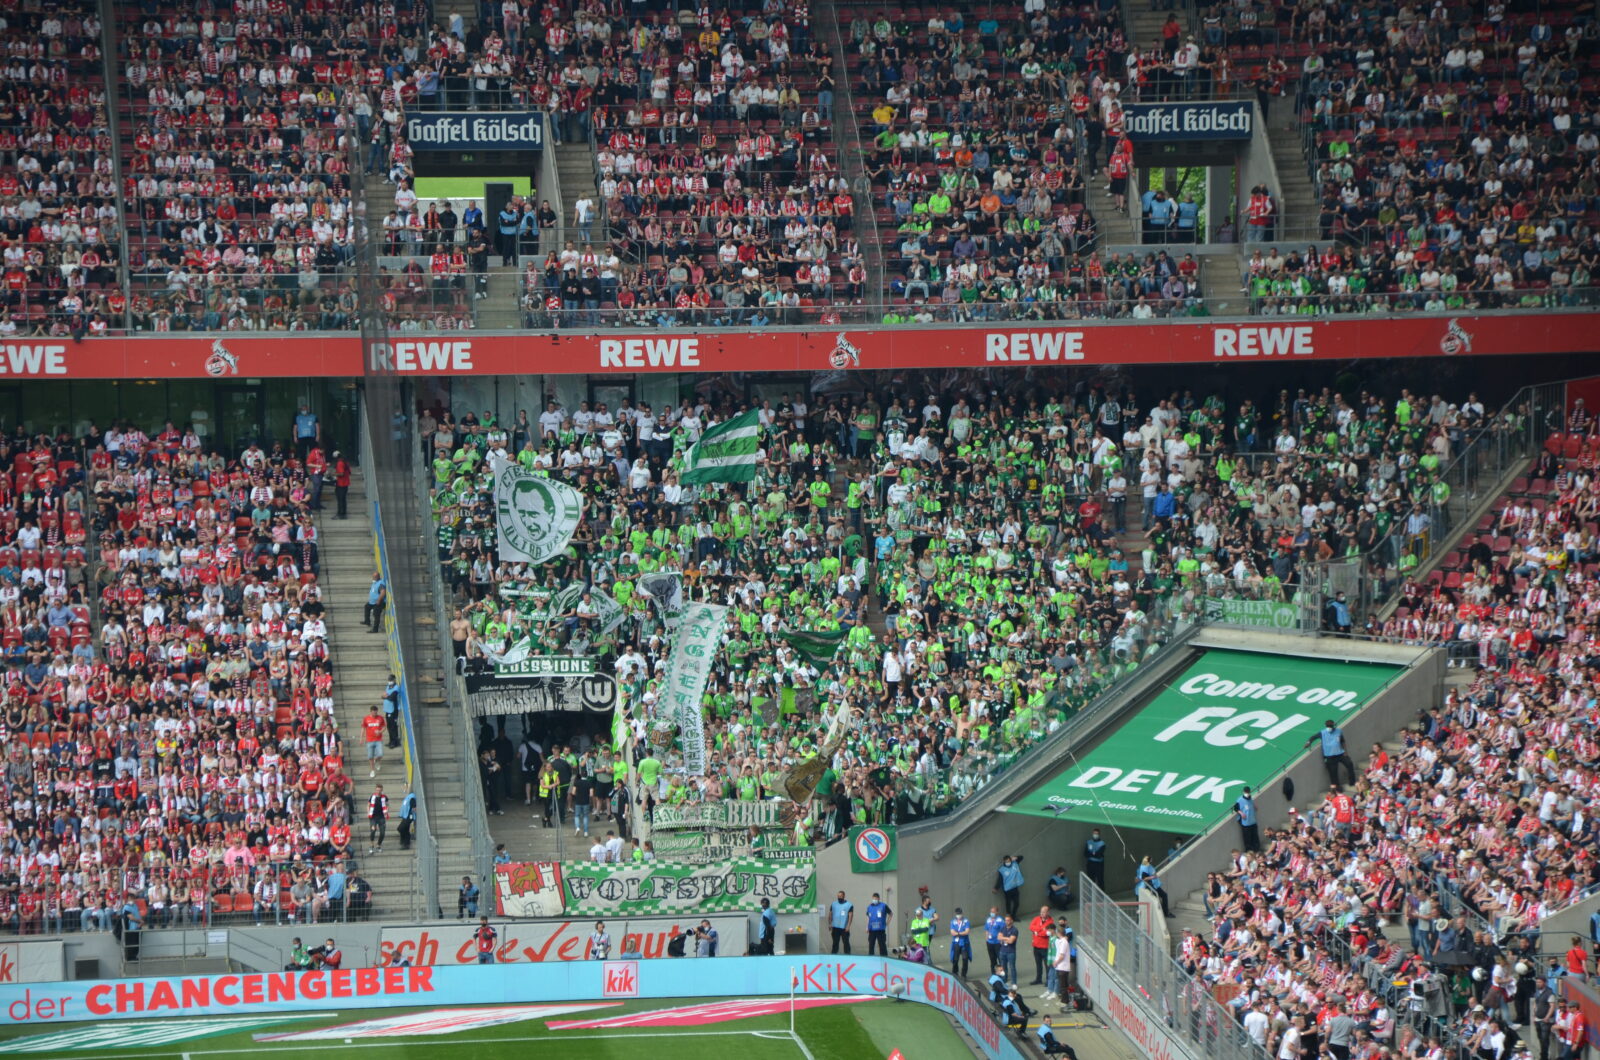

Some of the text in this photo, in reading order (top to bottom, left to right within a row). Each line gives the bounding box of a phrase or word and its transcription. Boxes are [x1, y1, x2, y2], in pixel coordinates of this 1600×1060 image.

[408, 117, 541, 145] Gaffel Kölsch
[1124, 106, 1251, 135] Gaffel Kölsch
[370, 342, 473, 371] REWE
[600, 338, 700, 368] REWE
[985, 332, 1085, 362] REWE
[1213, 326, 1315, 357] REWE
[1179, 673, 1358, 711] Come on,
[1153, 706, 1311, 751] FC!
[1067, 766, 1247, 803] DEVK
[1047, 795, 1204, 819] Gesagt. Getan. Geholfen.
[764, 850, 813, 859] SALZGITTER
[567, 872, 810, 901] WOLFSBURG
[8, 966, 435, 1021] der CHANCENGEBER
[606, 967, 634, 994] kik
[802, 961, 1001, 1053] KiK der CHANCENGEBER
